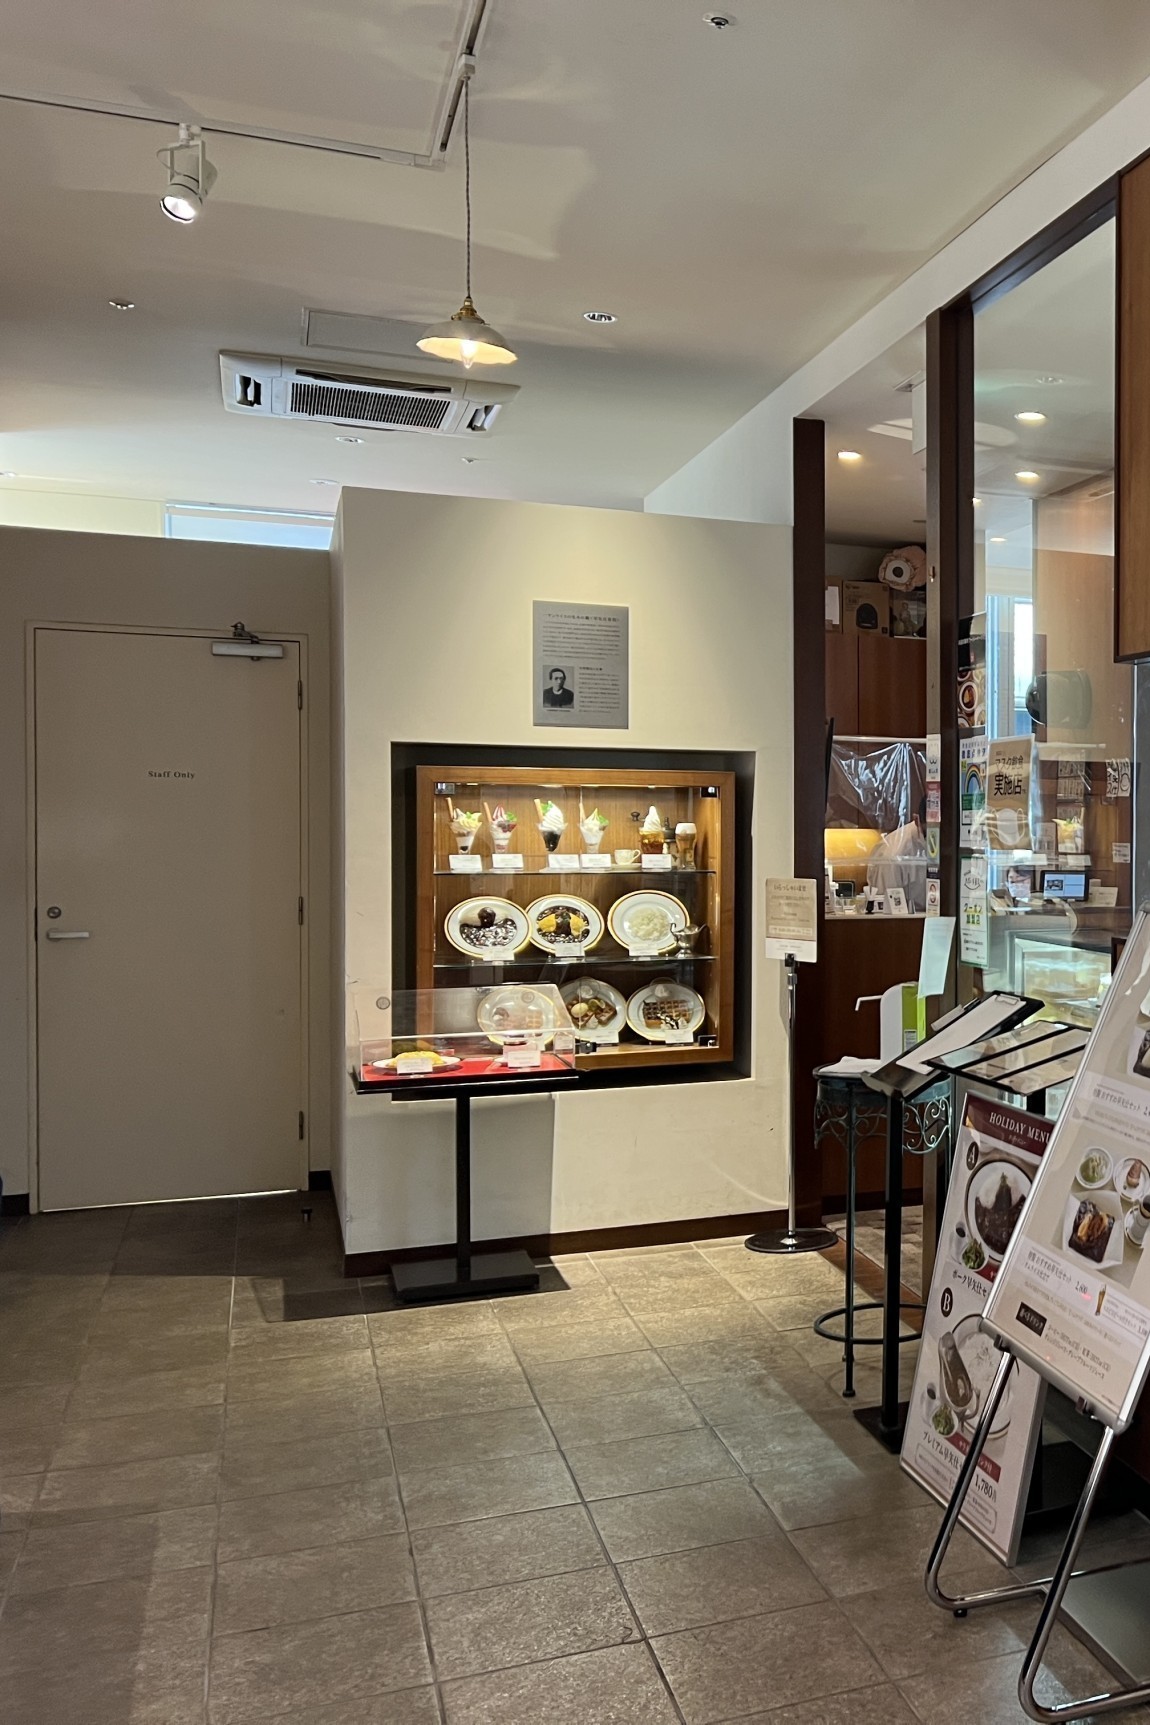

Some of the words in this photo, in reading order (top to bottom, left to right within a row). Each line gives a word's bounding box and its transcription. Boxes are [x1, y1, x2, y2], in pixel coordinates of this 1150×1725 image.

[148, 770, 171, 778] Staff
[173, 770, 195, 780] Only
[994, 773, 1022, 796] 実施店
[989, 1112, 1027, 1135] HOLIDAY
[967, 1145, 976, 1164] A
[943, 1292, 951, 1311] B
